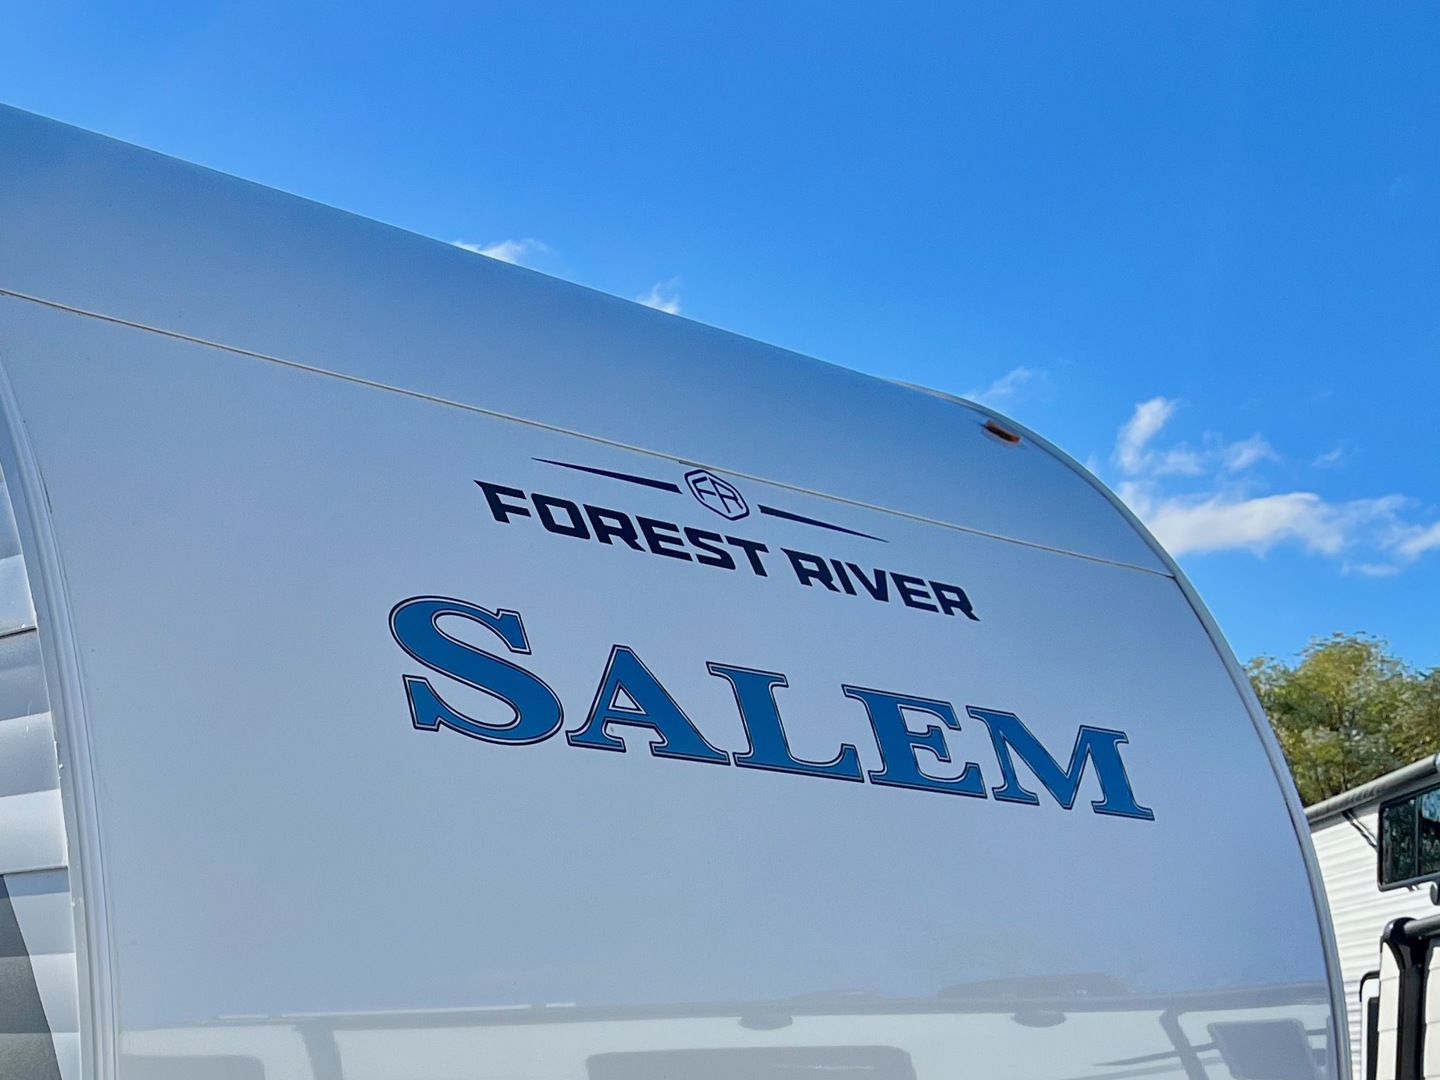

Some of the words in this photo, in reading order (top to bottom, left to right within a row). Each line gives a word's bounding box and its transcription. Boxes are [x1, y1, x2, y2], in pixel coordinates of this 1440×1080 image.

[473, 479, 769, 577] FOREST
[779, 547, 981, 622] RIVER
[388, 594, 1156, 822] SALEM
